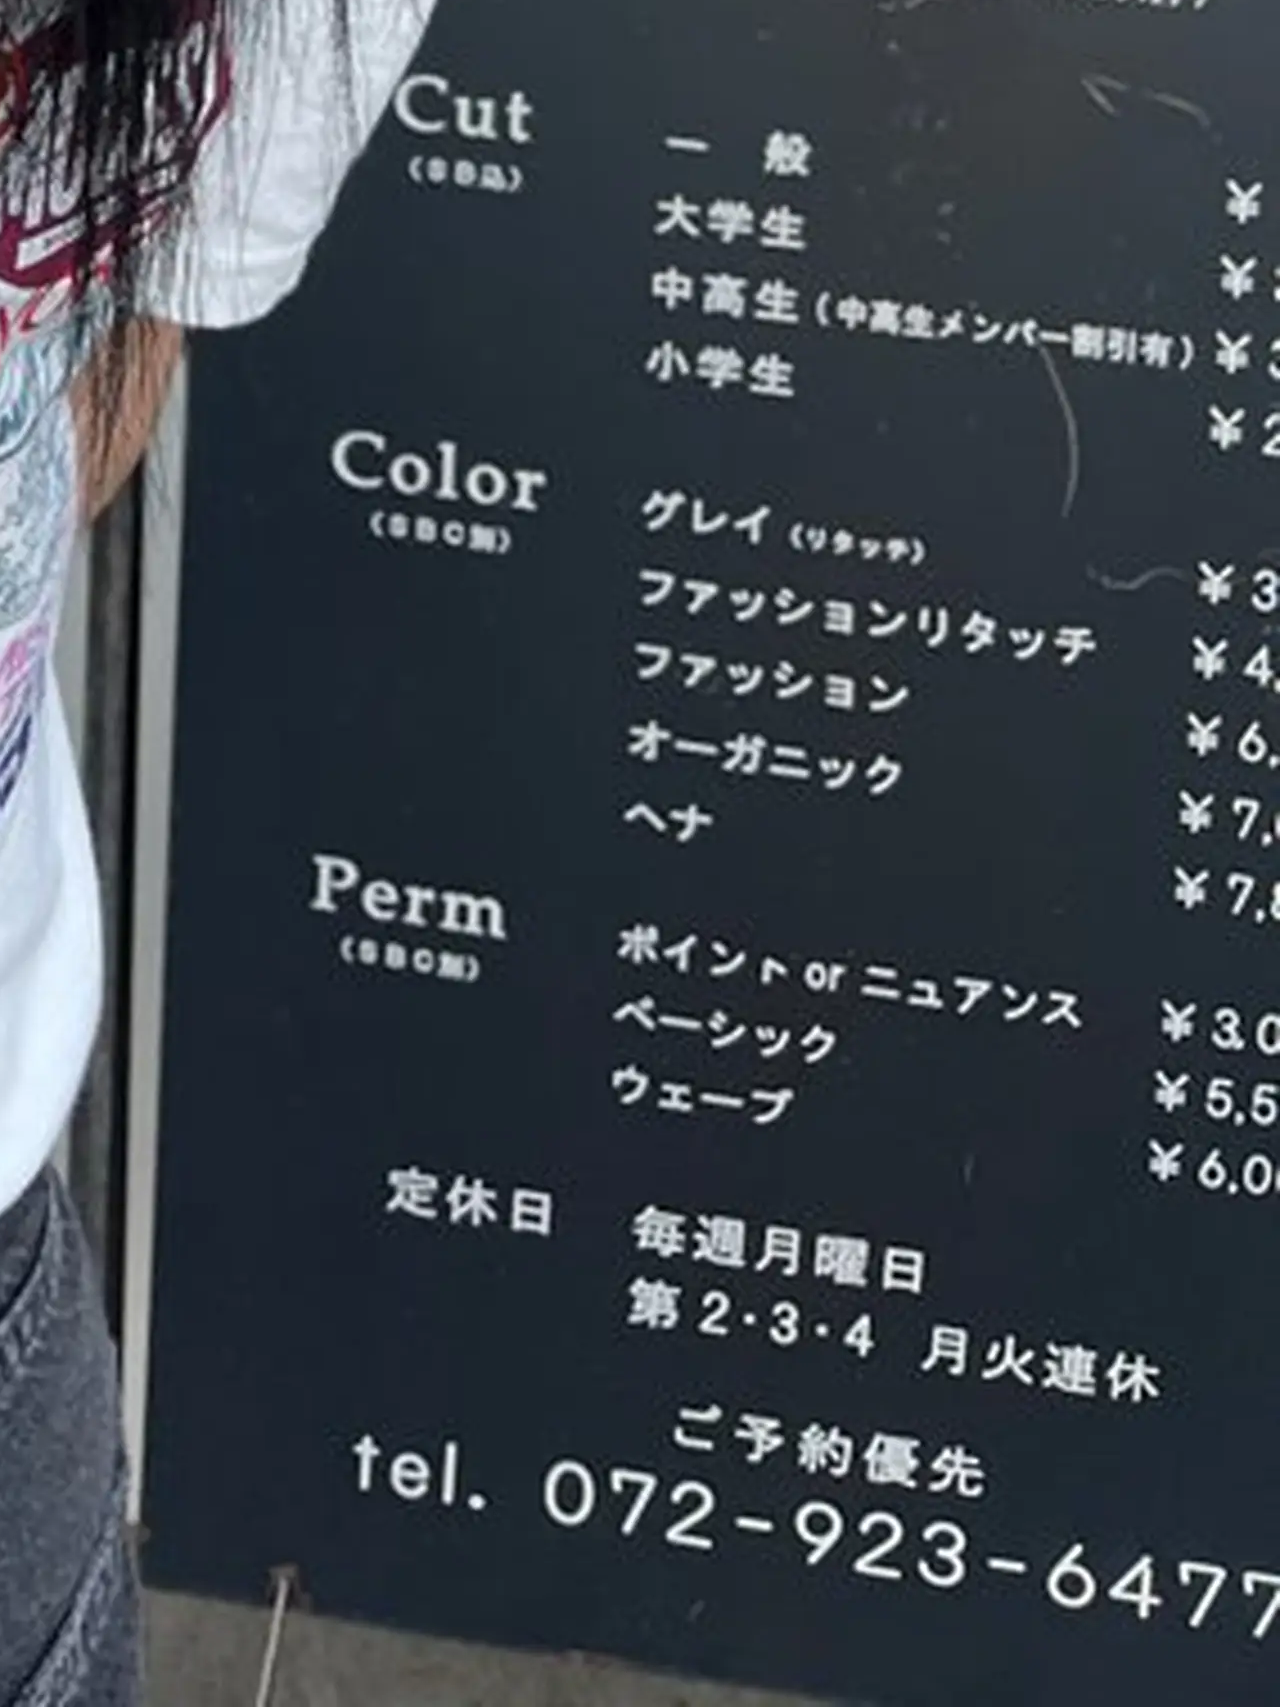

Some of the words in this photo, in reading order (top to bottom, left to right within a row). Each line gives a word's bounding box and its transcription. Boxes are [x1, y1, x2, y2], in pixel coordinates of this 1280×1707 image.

[395, 73, 534, 143] Cut
[653, 193, 807, 252] 大学生
[650, 266, 800, 324] 中高生
[645, 341, 795, 398] 小学生
[331, 429, 548, 512] Color
[642, 488, 771, 545] グレイ
[639, 568, 1098, 665] ファッションリタッチ
[633, 639, 911, 713] ファッション
[627, 718, 904, 794] オーガニック
[622, 800, 714, 843] ヘナ
[309, 852, 508, 940] Perm
[612, 995, 837, 1064] ベーシック
[804, 960, 848, 992] or
[861, 964, 1083, 1029] ニュアンス
[611, 1064, 794, 1125] ウェーブ
[386, 1165, 553, 1236] 定休日
[632, 1204, 927, 1295] 毎週月曜日
[920, 1323, 1161, 1405] 月火連休
[672, 1403, 987, 1500] ご予約優先
[351, 1433, 487, 1512] tel.
[542, 1459, 1280, 1640] 072-923-6477
